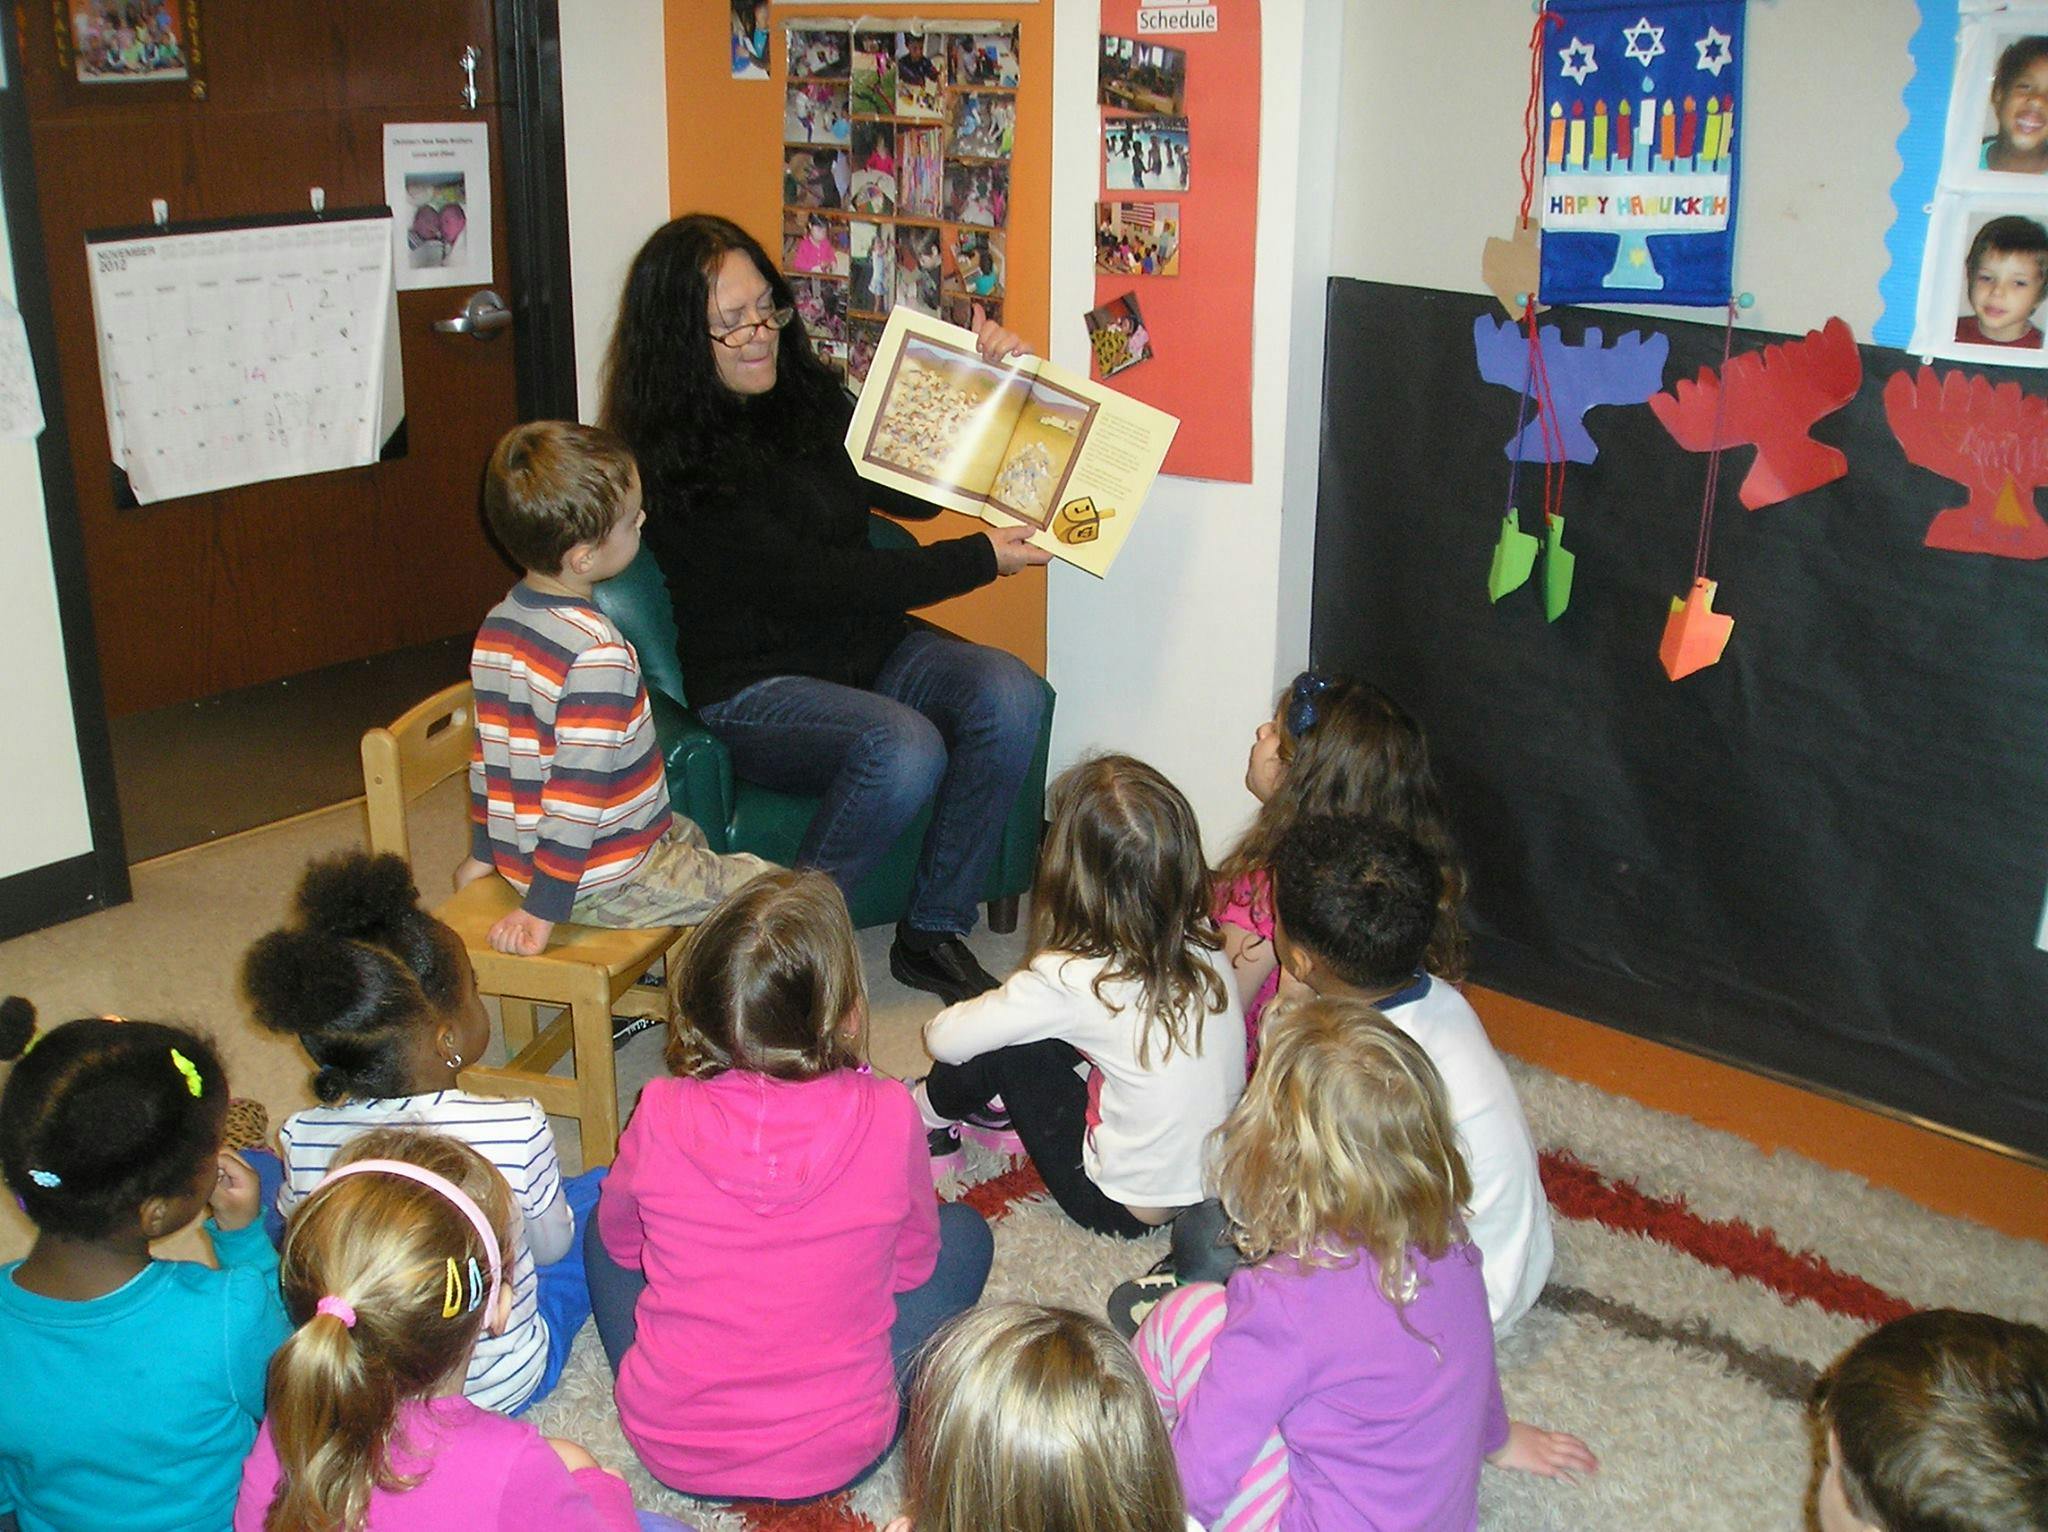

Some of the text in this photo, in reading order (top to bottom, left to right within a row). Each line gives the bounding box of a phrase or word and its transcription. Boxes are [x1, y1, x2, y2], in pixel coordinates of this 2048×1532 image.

[1139, 9, 1216, 29] Schedule
[1550, 194, 1728, 216] HAPPY HANUKKAH
[97, 245, 157, 260] NOVEMBER
[99, 259, 128, 273] 2012
